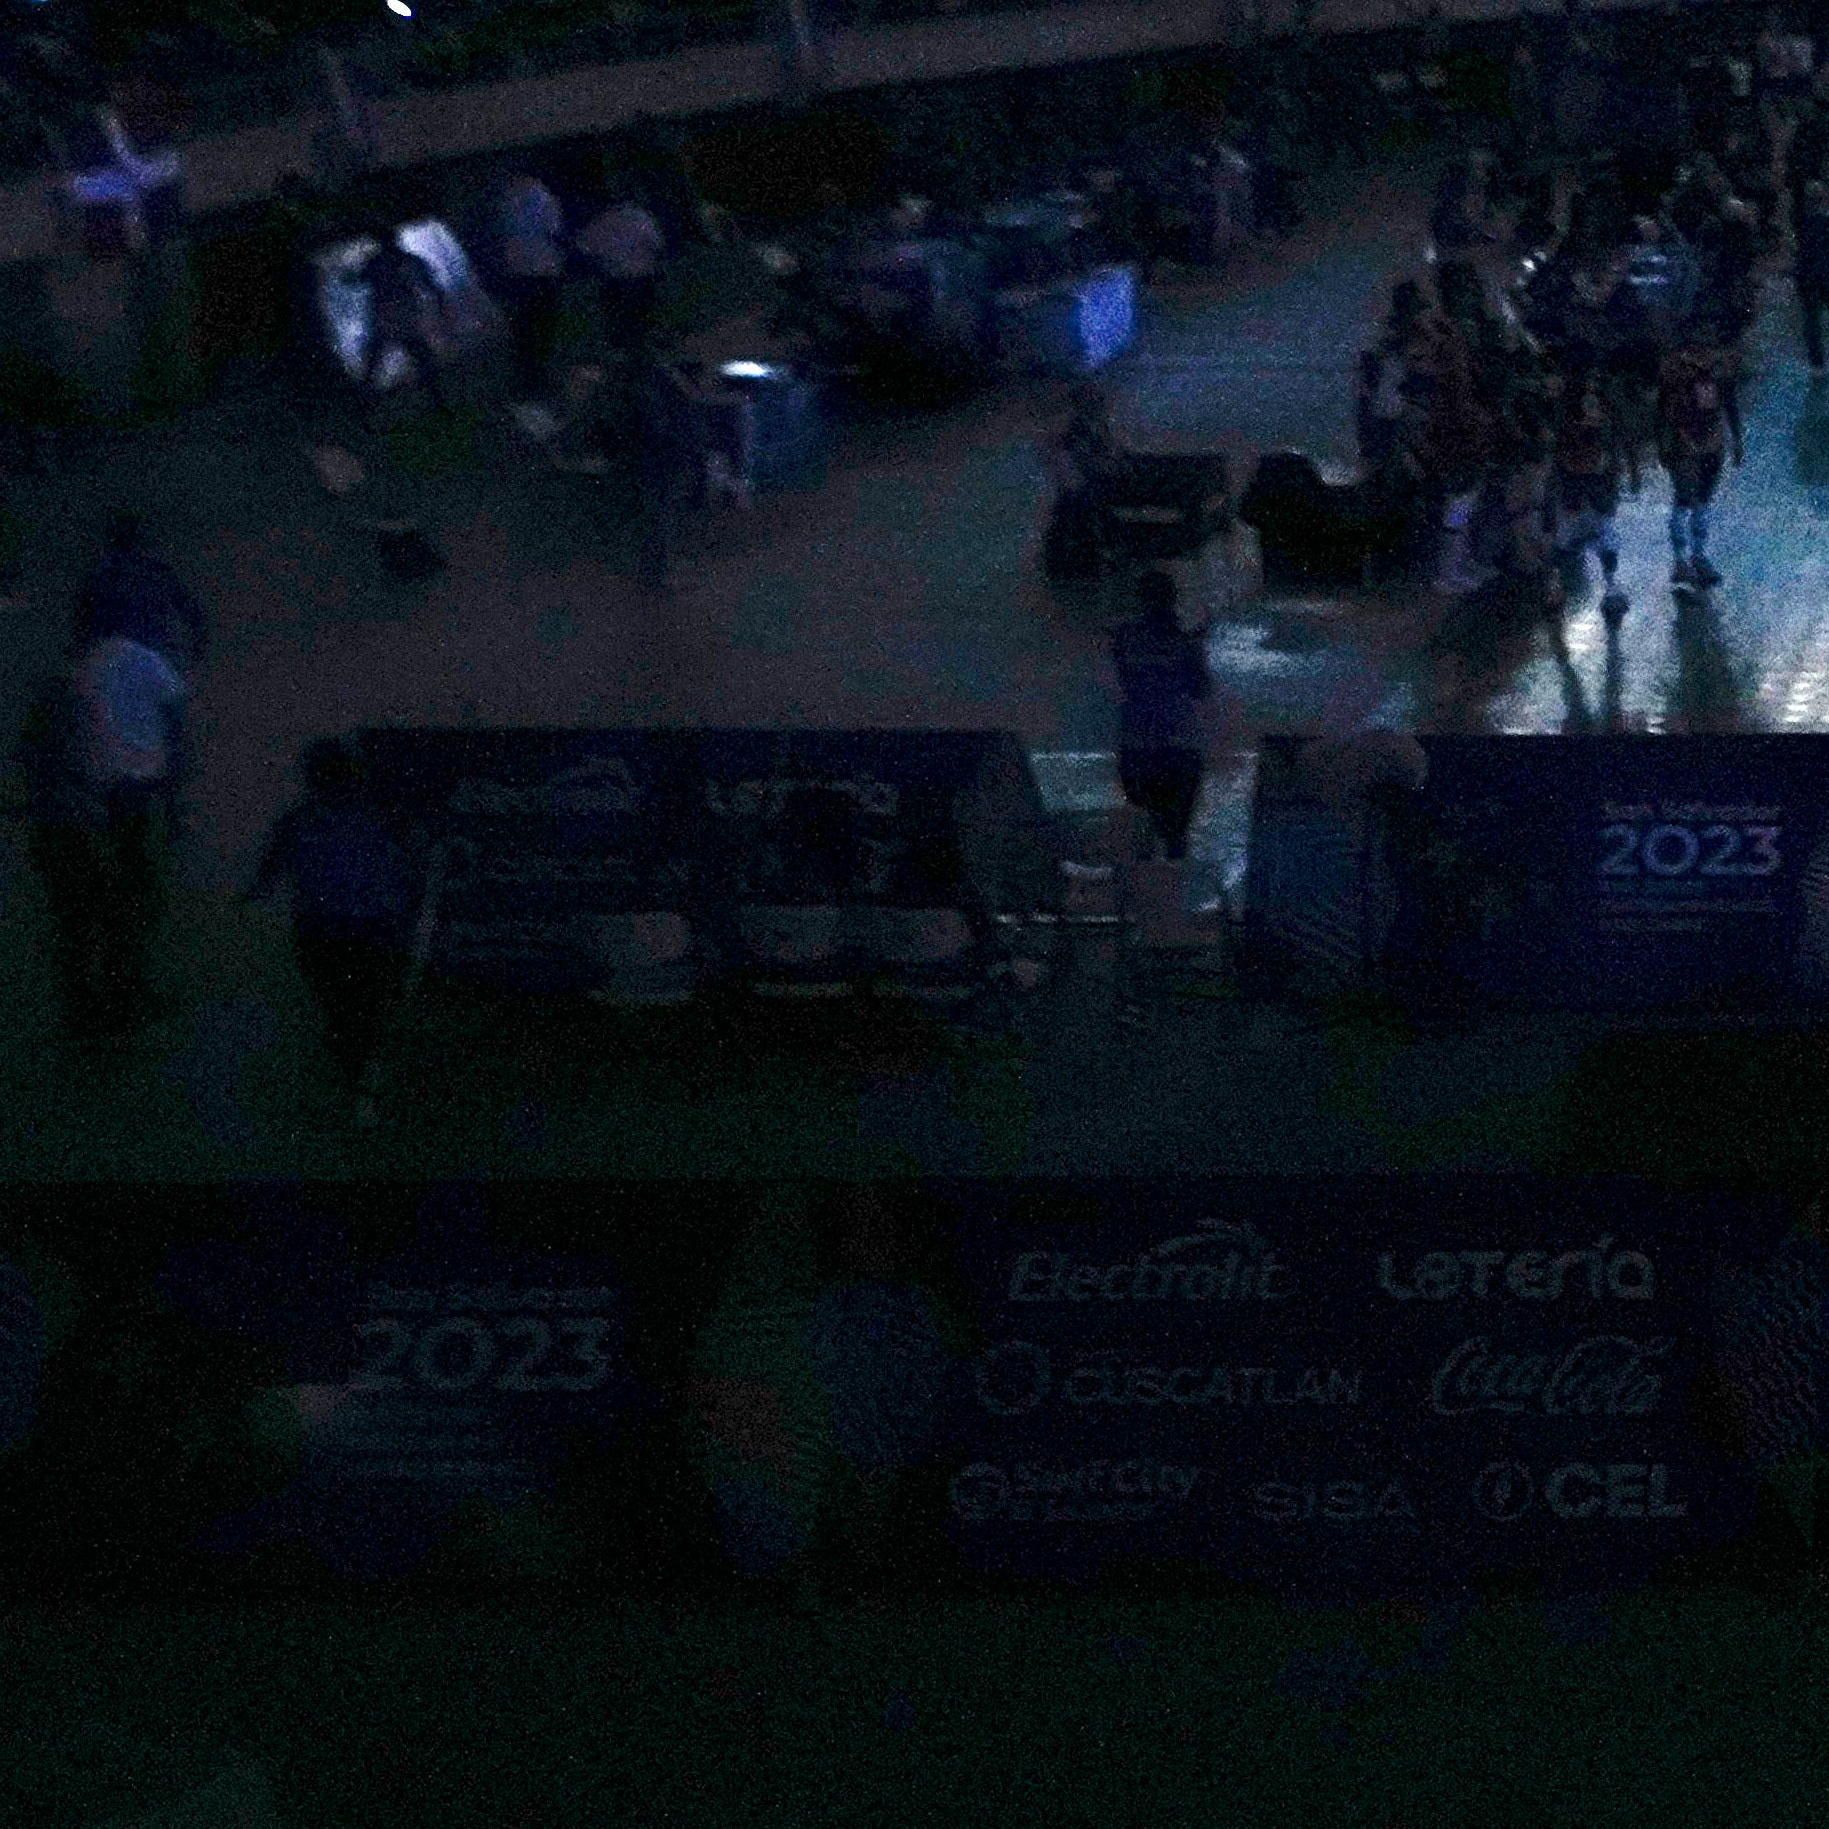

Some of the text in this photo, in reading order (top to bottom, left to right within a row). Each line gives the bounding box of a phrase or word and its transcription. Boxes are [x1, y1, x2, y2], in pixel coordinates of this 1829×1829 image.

[1599, 823, 1783, 877] 2023
[1006, 1245, 1291, 1304] Electrolit
[347, 1315, 615, 1394] 2023
[1431, 1334, 1677, 1418] Coca-Cola
[1062, 1365, 1366, 1409] CUSCATLAN
[1251, 1478, 1418, 1525] SISA
[1542, 1462, 1689, 1521] CEL
